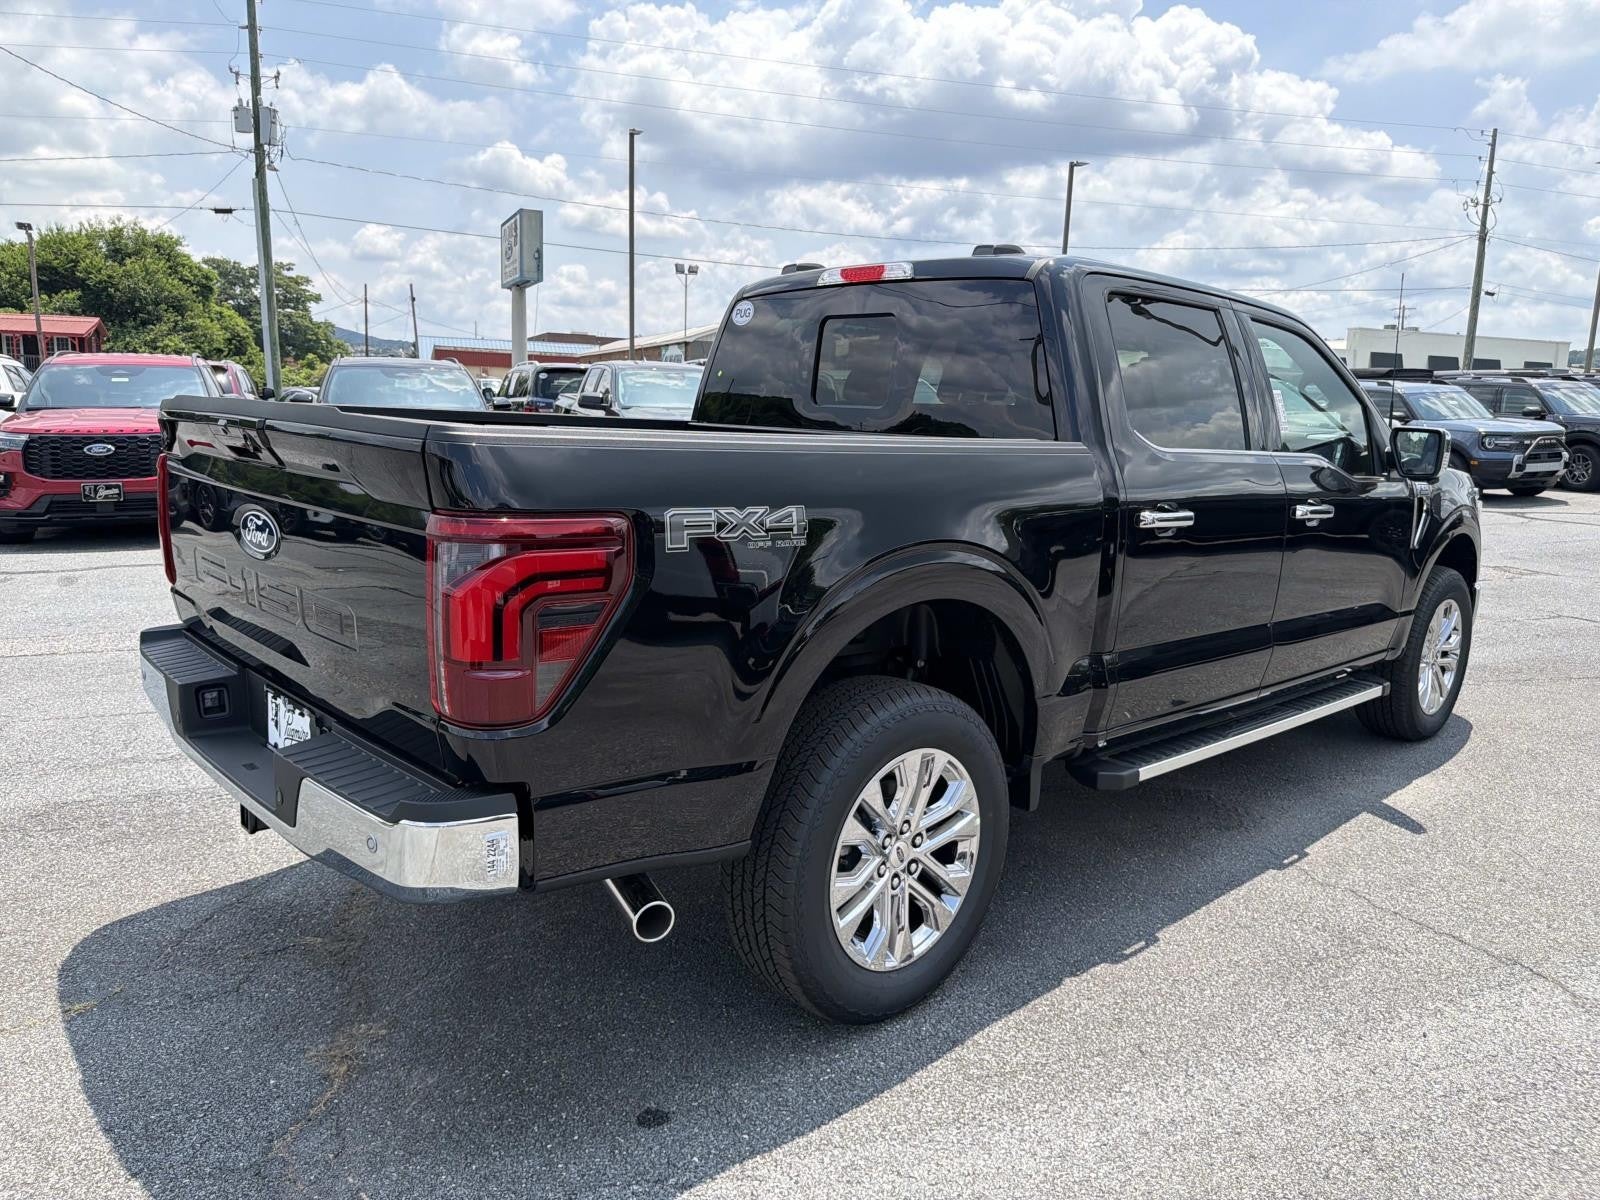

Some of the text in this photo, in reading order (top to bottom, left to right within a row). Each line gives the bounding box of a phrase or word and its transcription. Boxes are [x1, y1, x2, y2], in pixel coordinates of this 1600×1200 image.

[735, 307, 752, 318] PUG
[246, 515, 270, 547] Ford
[664, 505, 808, 552] FX4
